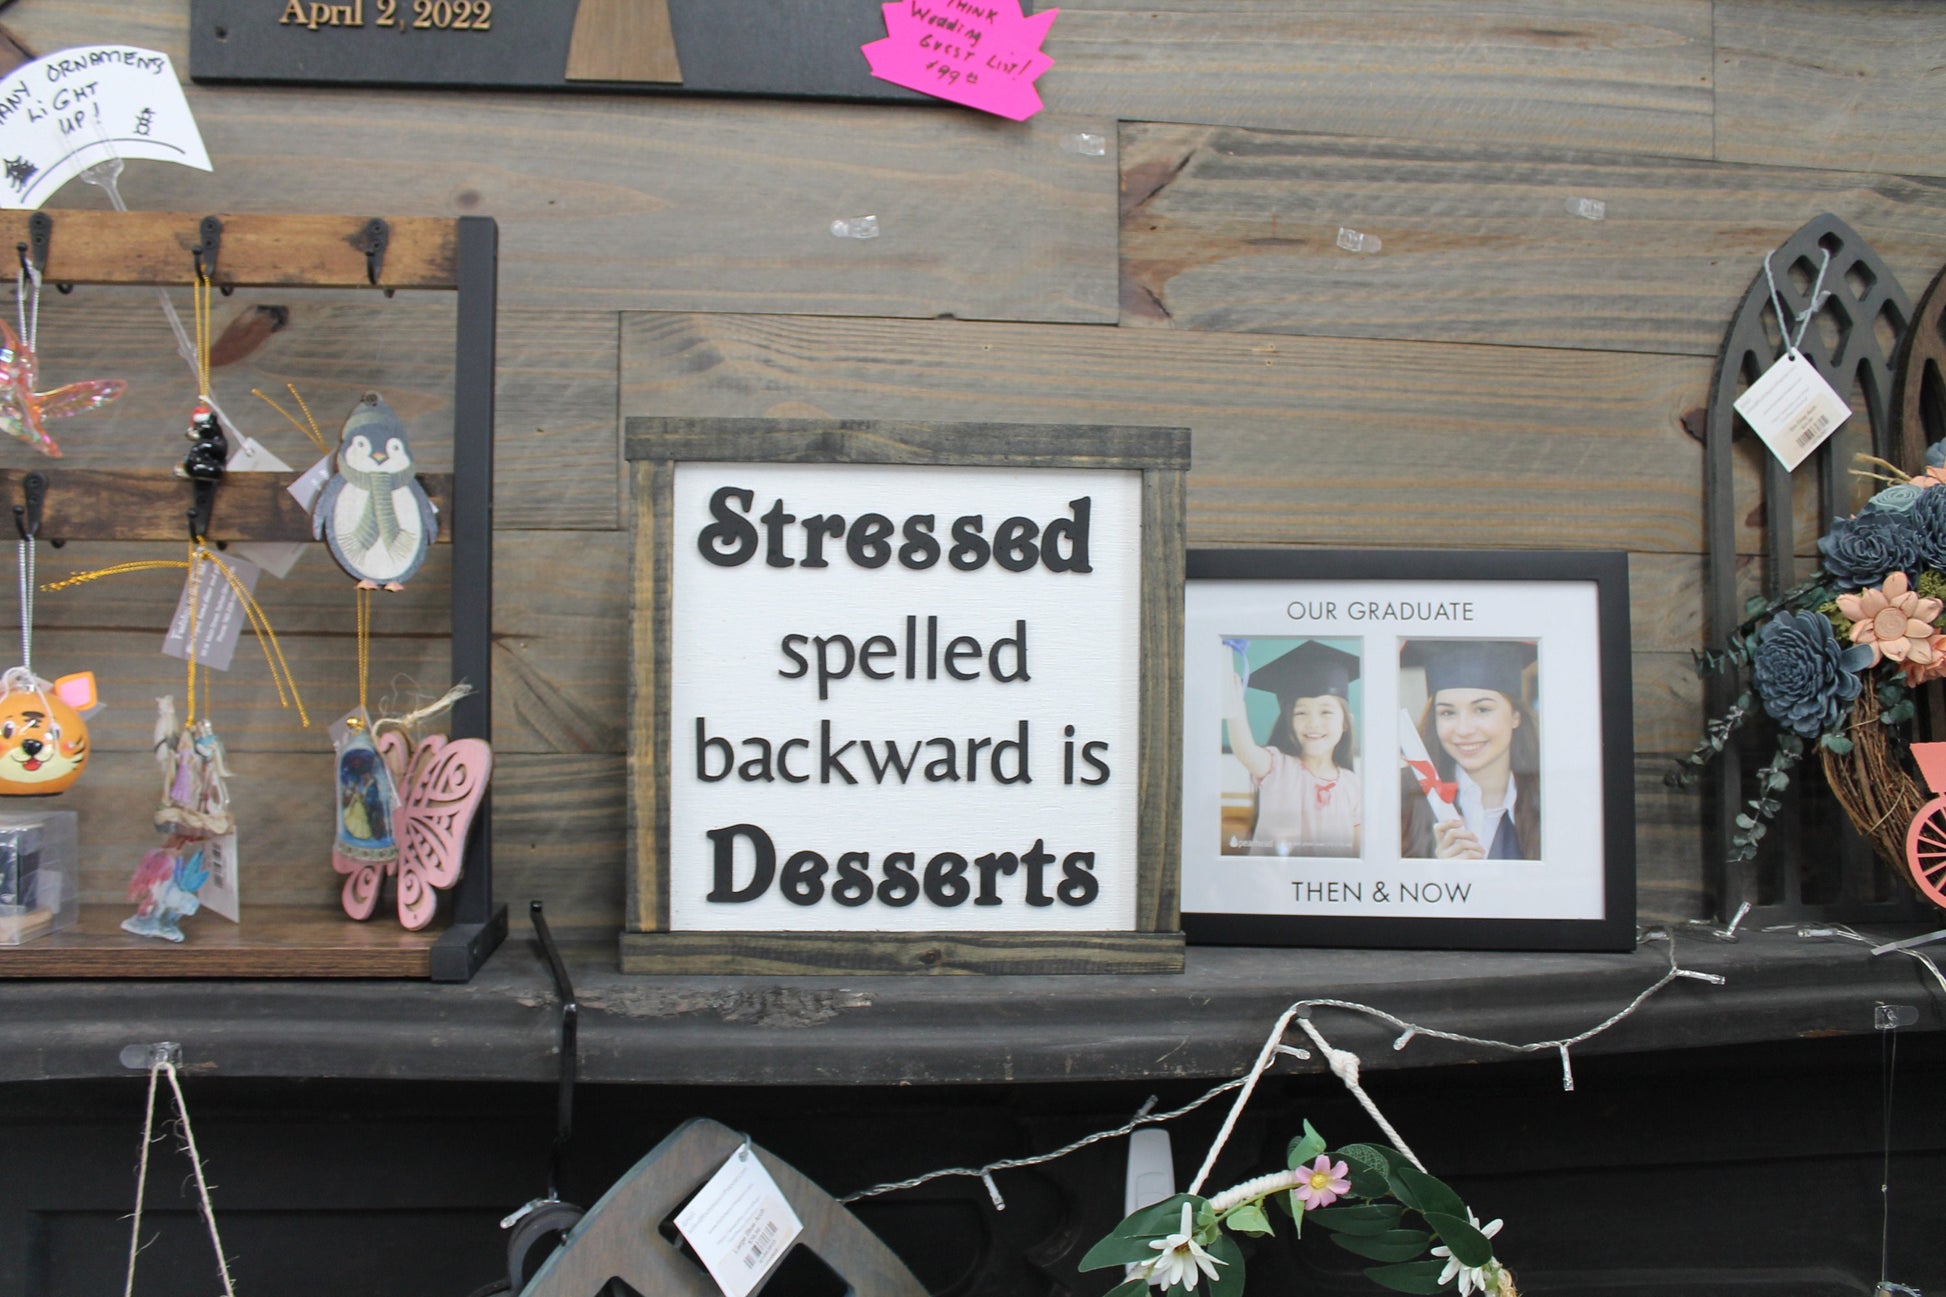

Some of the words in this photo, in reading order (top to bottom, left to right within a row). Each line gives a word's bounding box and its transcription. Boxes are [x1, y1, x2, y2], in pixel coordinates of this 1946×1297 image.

[278, 0, 364, 30] April
[0, 80, 31, 126] ANY
[58, 102, 100, 135] UP!
[697, 486, 1094, 574] Stressed
[1286, 601, 1337, 621] OUR
[1347, 601, 1475, 622] GRADUATE
[778, 615, 1032, 701] spelled
[695, 716, 1033, 785] backward
[1064, 724, 1111, 786] is
[706, 823, 1100, 908] Desserts
[1291, 881, 1362, 902] THEN
[1372, 880, 1390, 903] &
[1400, 882, 1473, 903] NOW
